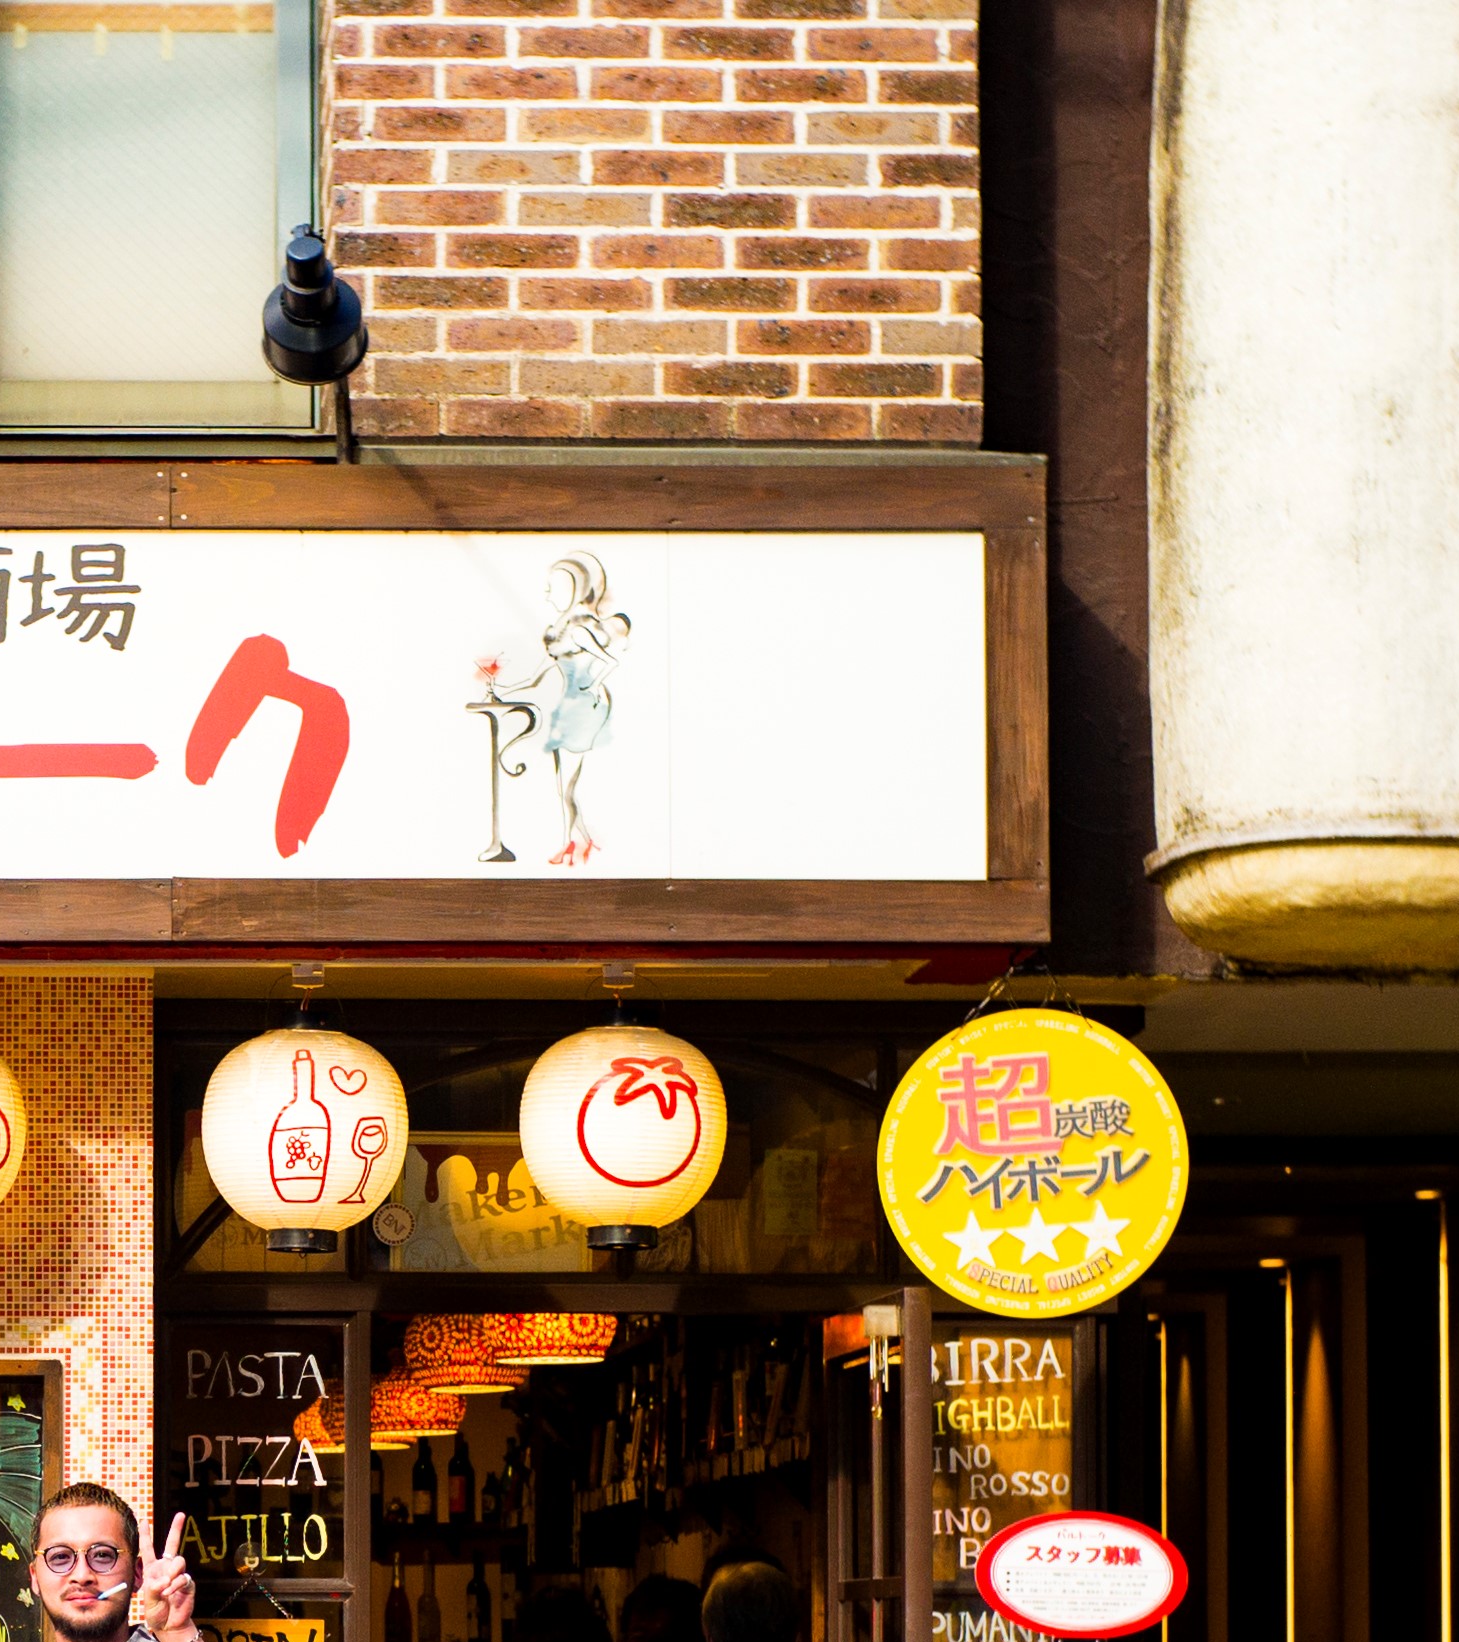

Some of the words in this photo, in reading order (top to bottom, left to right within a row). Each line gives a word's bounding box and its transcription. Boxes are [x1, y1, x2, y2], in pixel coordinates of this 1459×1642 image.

[917, 1147, 1151, 1210] ハイボール
[968, 1261, 1039, 1294] SPECIAL
[1046, 1252, 1115, 1293] QUALITY
[185, 1348, 330, 1400] PASTA
[933, 1394, 1070, 1437] IGHBALL
[184, 1434, 328, 1488] PIZZA
[933, 1443, 991, 1473] INO
[970, 1471, 1071, 1501] ROSSO
[181, 1512, 328, 1563] AJILLO
[933, 1507, 991, 1535] INO
